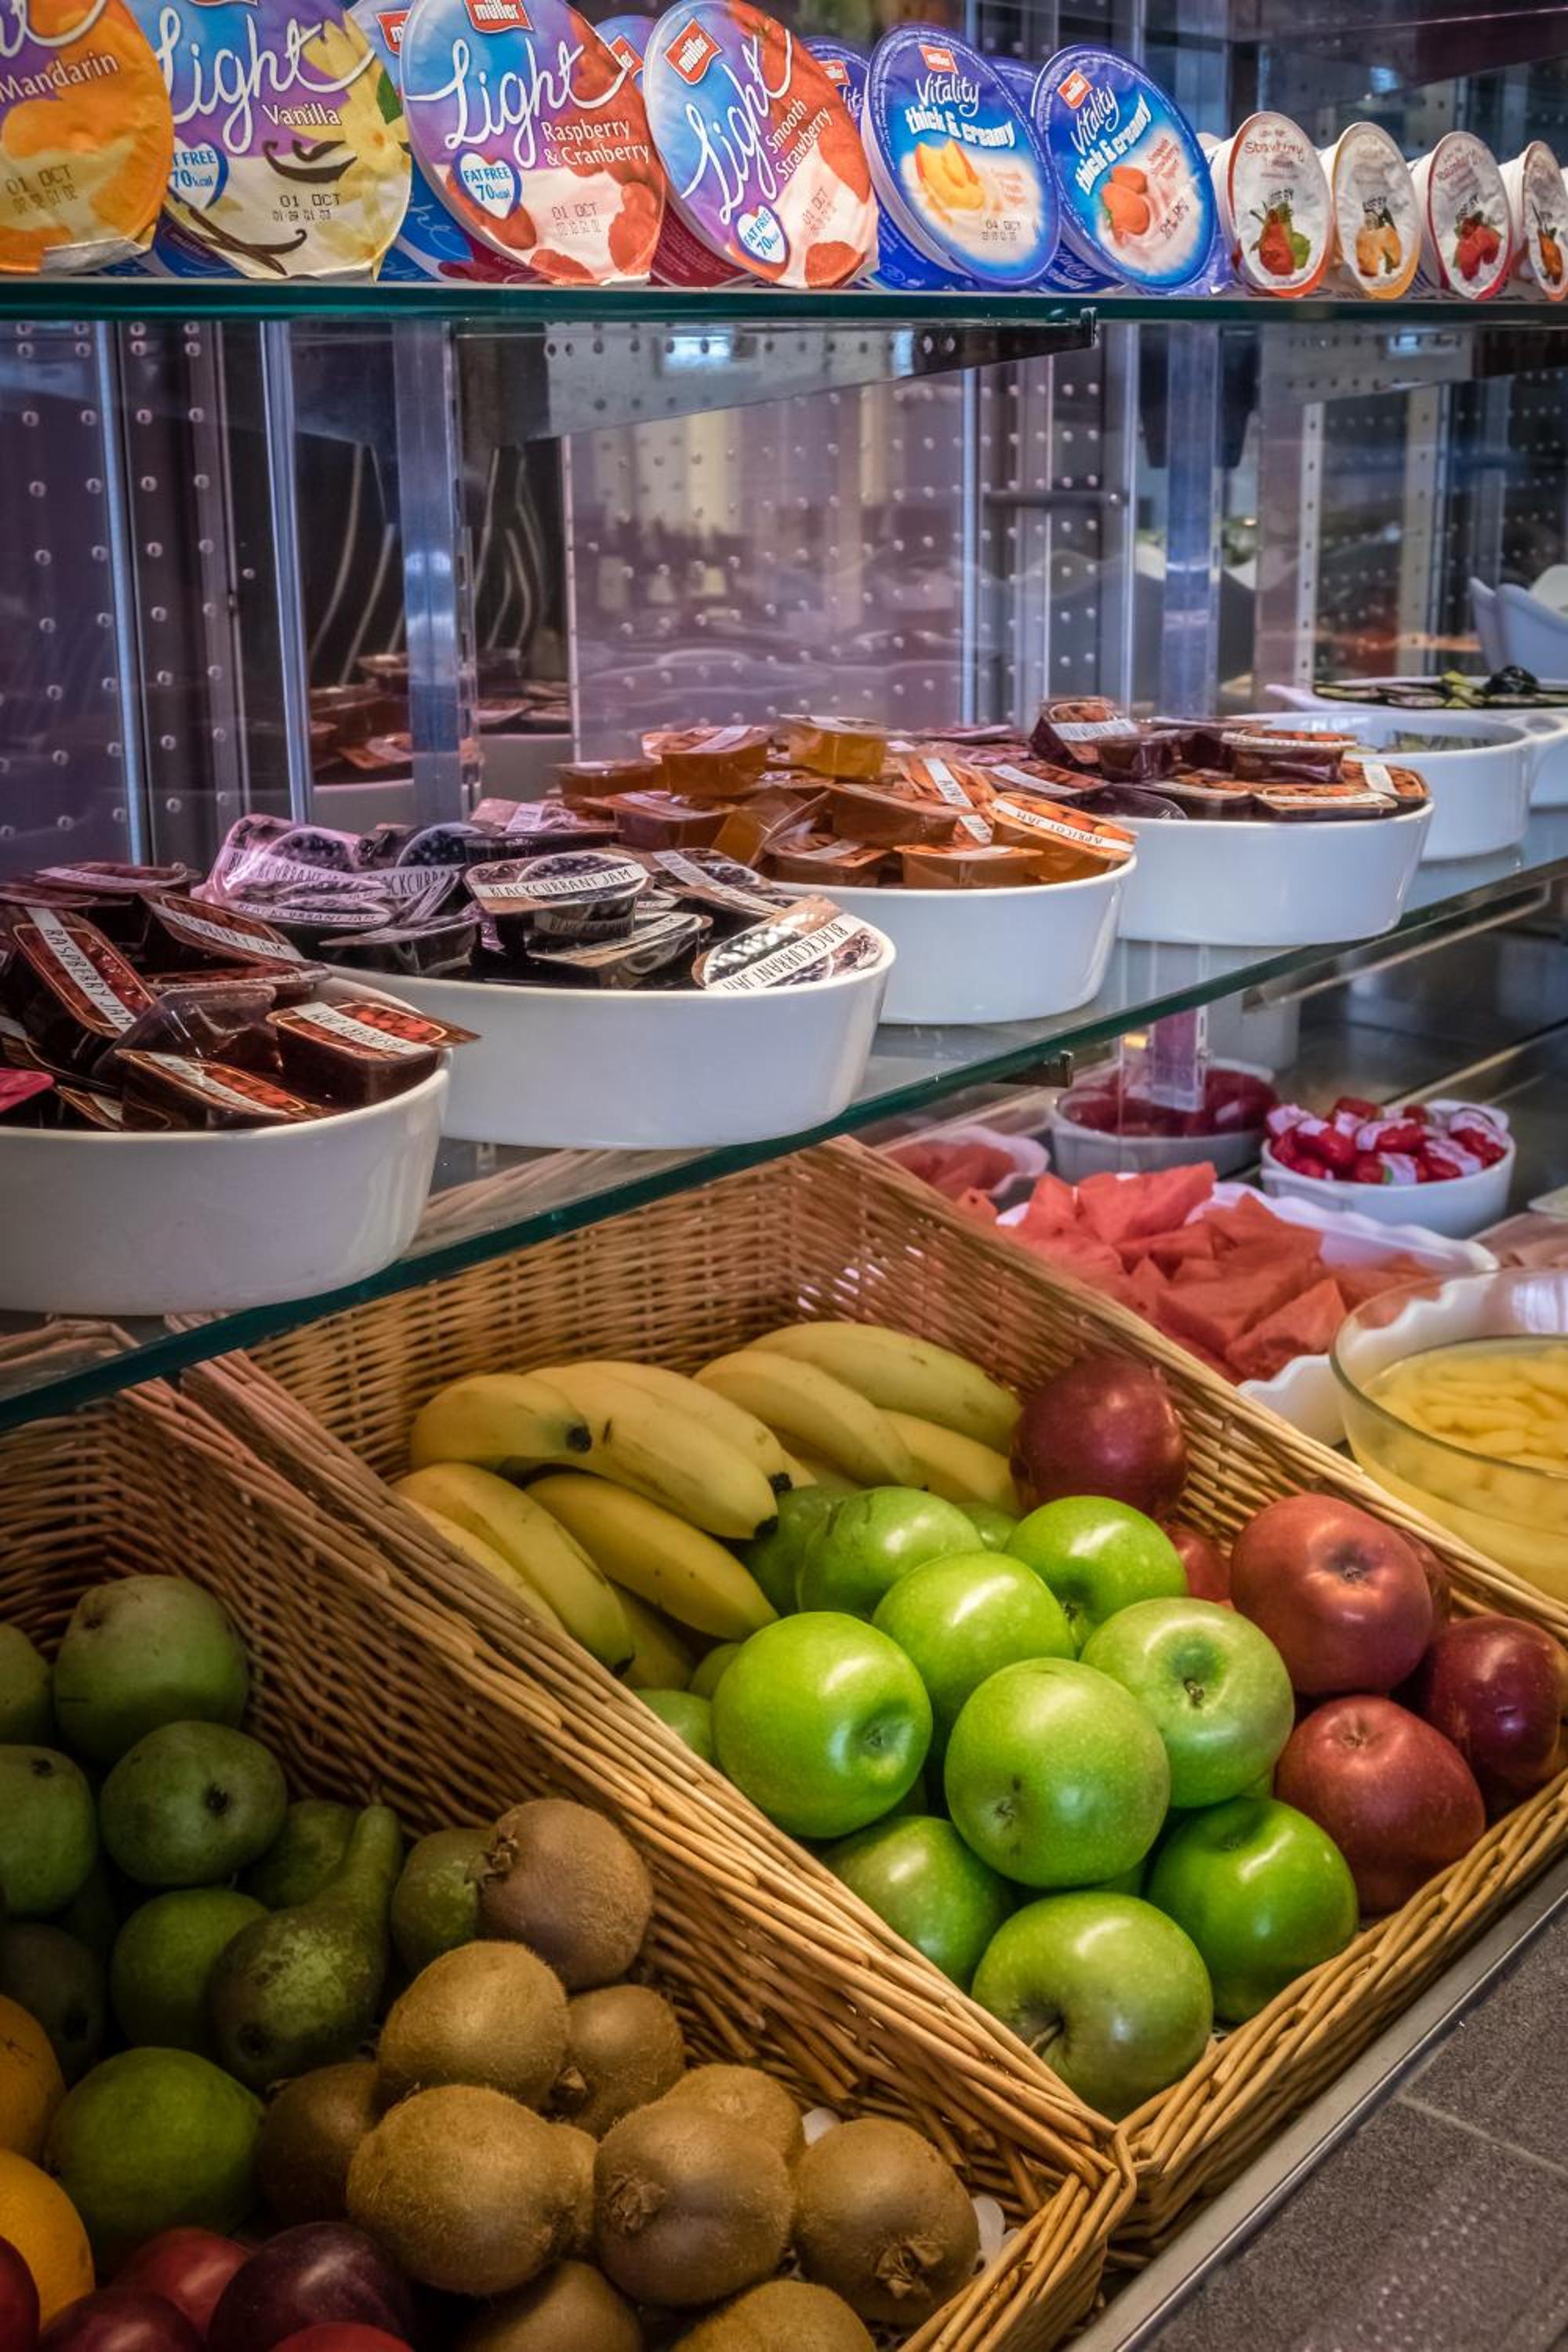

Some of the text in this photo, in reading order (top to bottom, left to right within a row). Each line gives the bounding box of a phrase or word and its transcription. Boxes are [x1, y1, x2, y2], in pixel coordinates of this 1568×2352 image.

[0, 51, 119, 103] Mandarin
[157, 8, 376, 154] Light
[916, 74, 980, 118] Vitality
[261, 103, 342, 127] Vanilla
[406, 38, 629, 169] Light
[1070, 81, 1120, 156] Vitality
[540, 119, 630, 143] Raspberry
[680, 29, 793, 226] Light
[765, 97, 808, 155] Smooth
[775, 107, 834, 182] Strawberry
[904, 104, 946, 135] thick
[960, 120, 1015, 148] creamy
[1075, 146, 1109, 195] thick
[1111, 93, 1152, 154] creamy
[183, 150, 217, 165] FREE
[463, 166, 510, 183] FAT FREE
[544, 143, 652, 166] & Cranberry
[5, 163, 72, 196] 01 OCT
[279, 193, 341, 209] 01 OCT
[551, 201, 600, 220] 01 OCT
[744, 224, 758, 244] FAT
[1016, 810, 1104, 845] APRICOT JAM
[489, 867, 633, 898] BLACKCURRANT JAM
[754, 922, 849, 984] BLACKCURRANT
[43, 929, 134, 1025] RASPBERRY JAM
